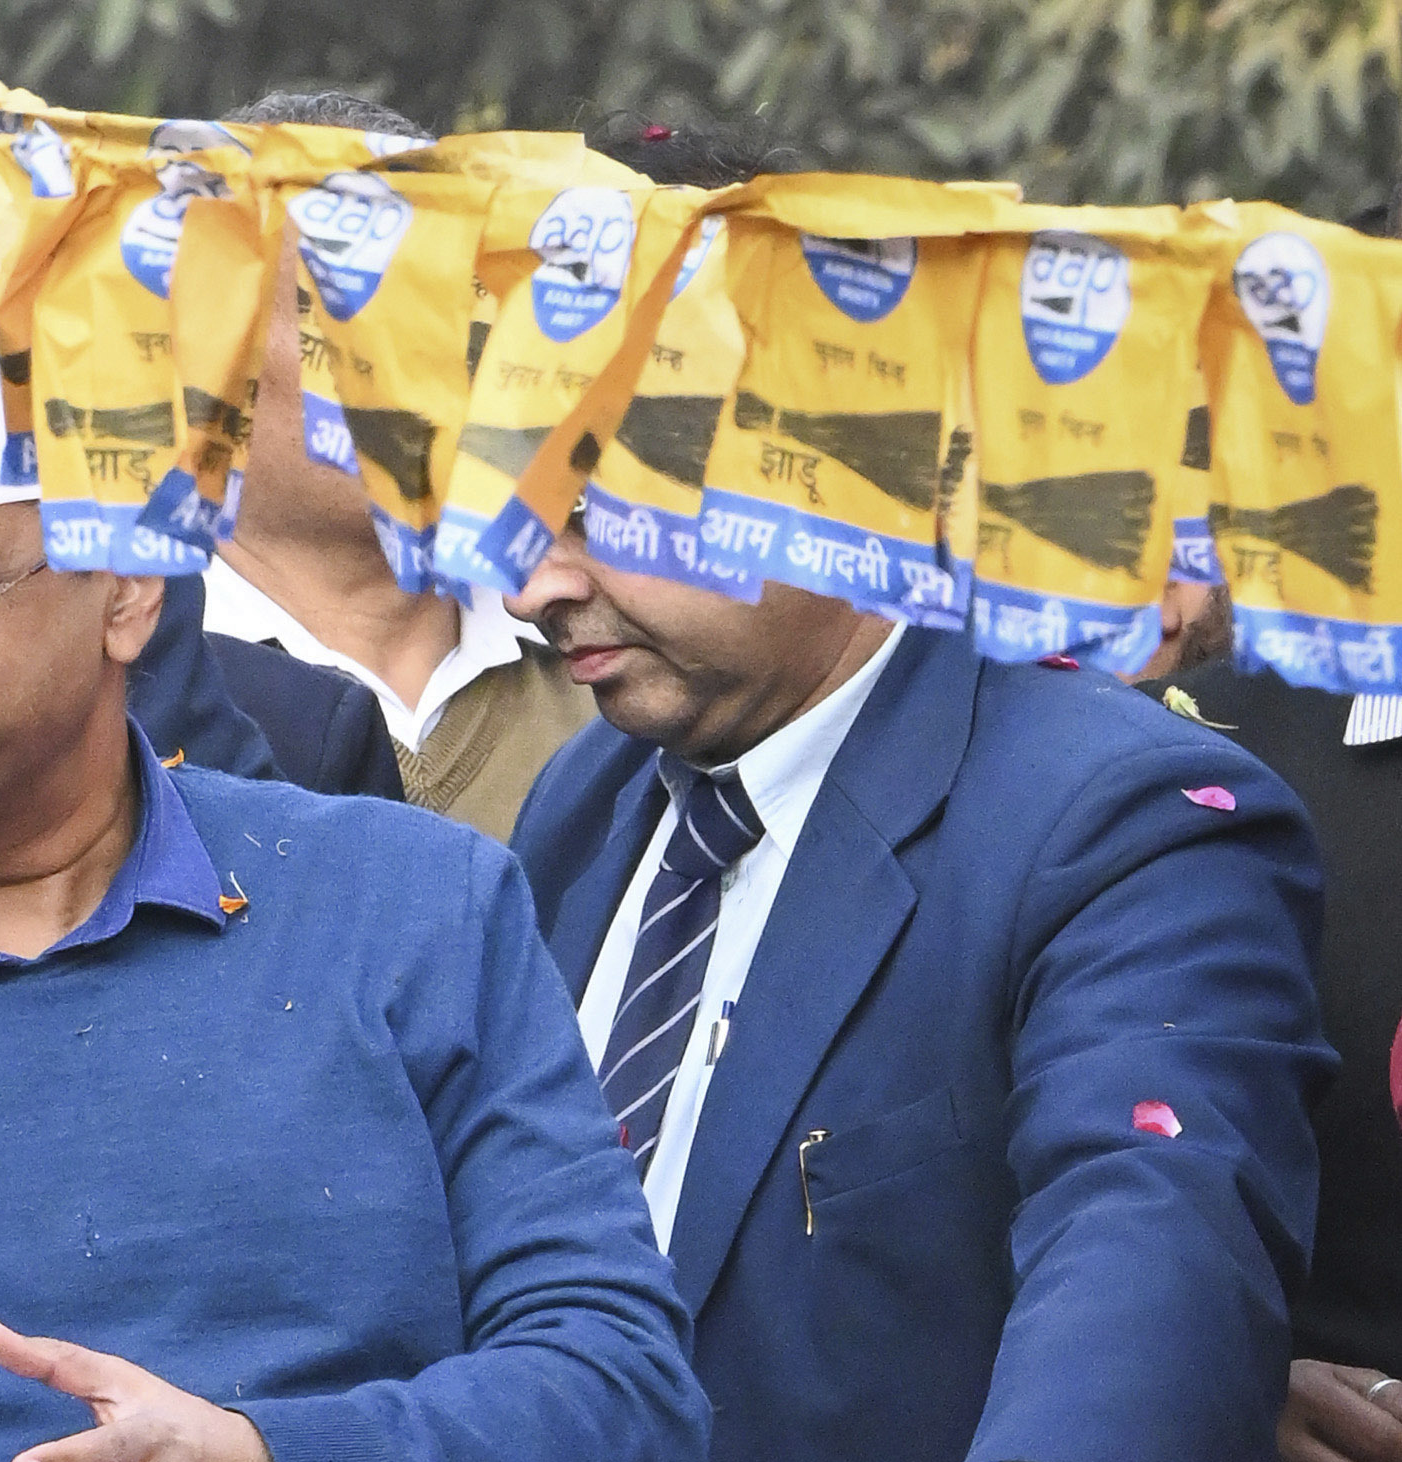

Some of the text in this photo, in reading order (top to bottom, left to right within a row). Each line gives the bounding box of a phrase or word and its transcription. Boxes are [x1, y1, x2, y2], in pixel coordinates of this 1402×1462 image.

[760, 440, 827, 507] झाडू
[700, 508, 777, 560] आम
[786, 531, 890, 592] आदमी
